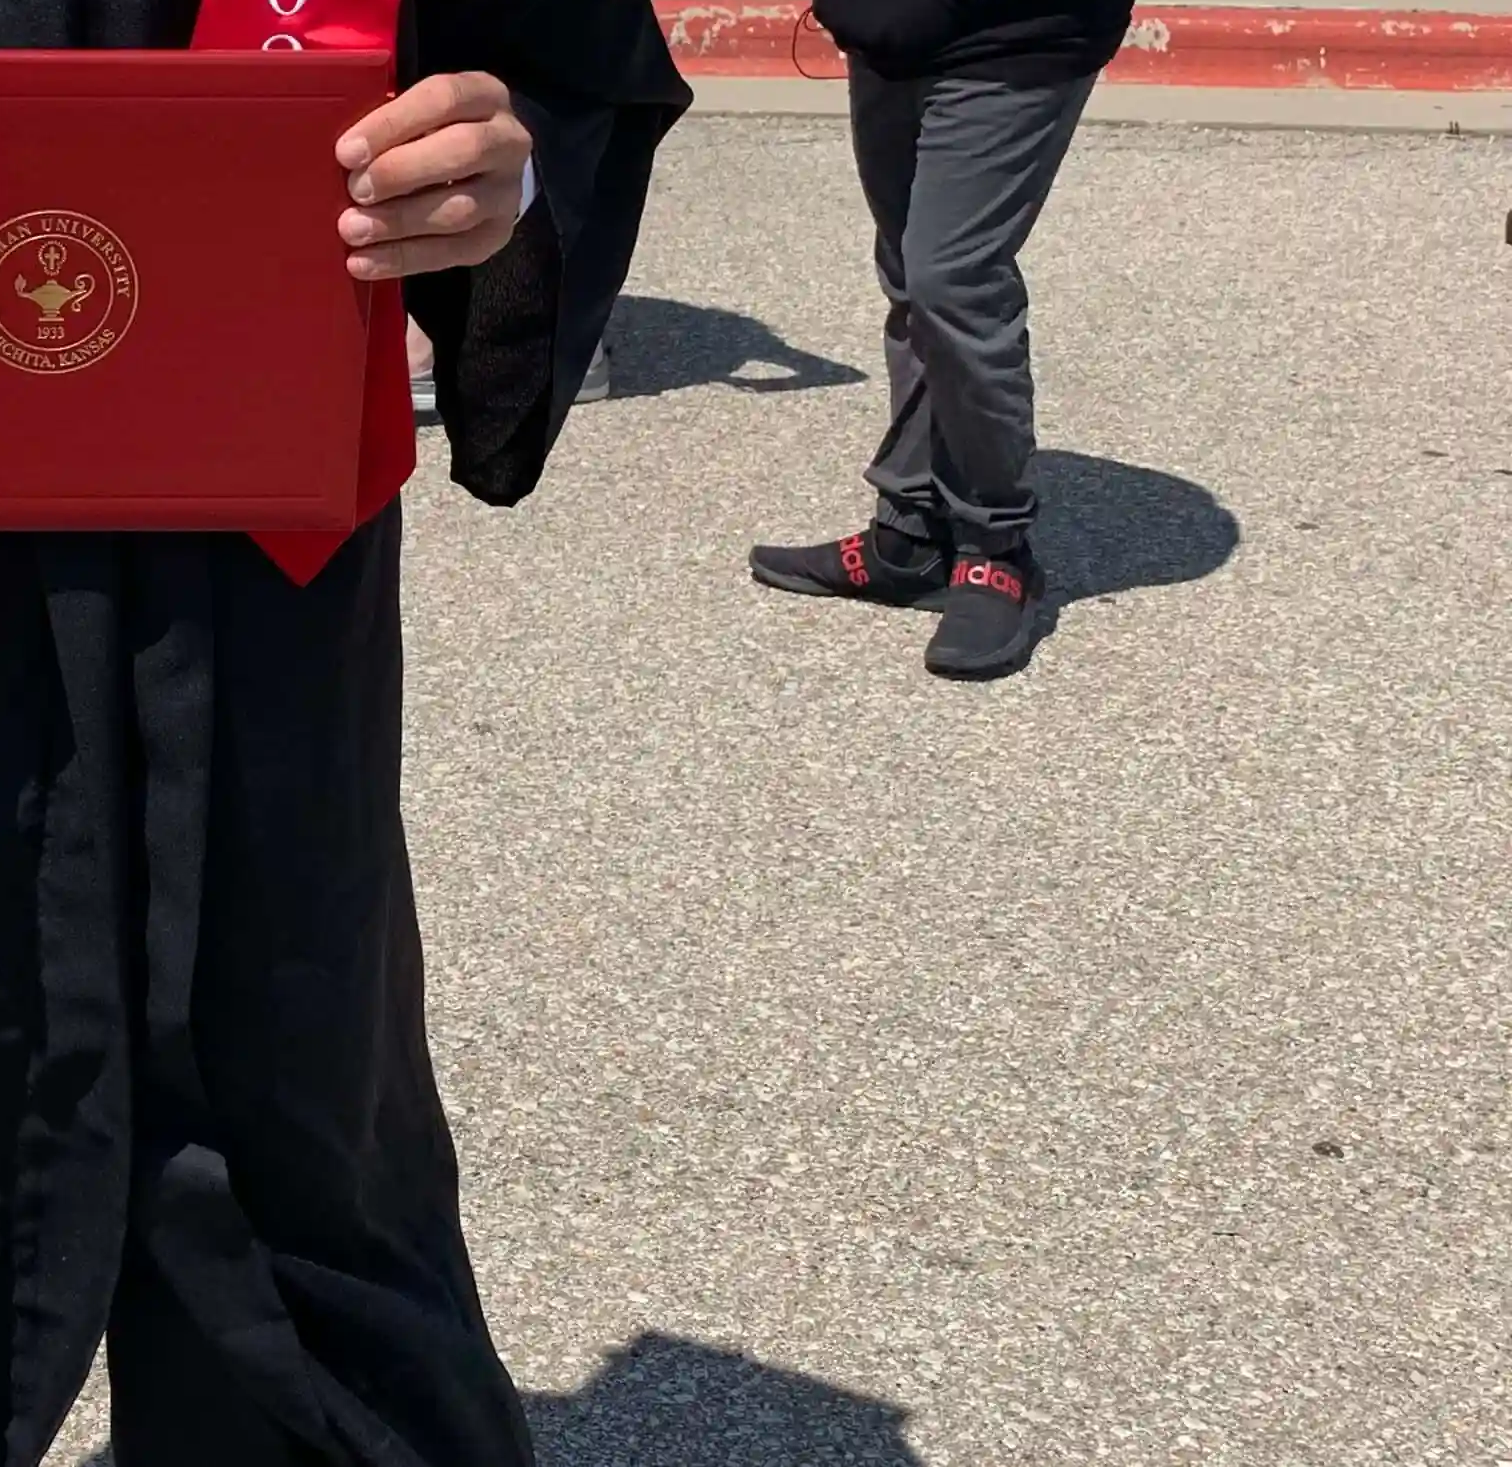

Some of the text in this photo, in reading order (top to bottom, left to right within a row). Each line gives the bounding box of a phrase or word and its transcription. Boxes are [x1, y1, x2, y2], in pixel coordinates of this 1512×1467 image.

[40, 217, 130, 299] UNIVERSITY
[37, 326, 65, 339] 1933
[59, 328, 116, 366] KANSAS
